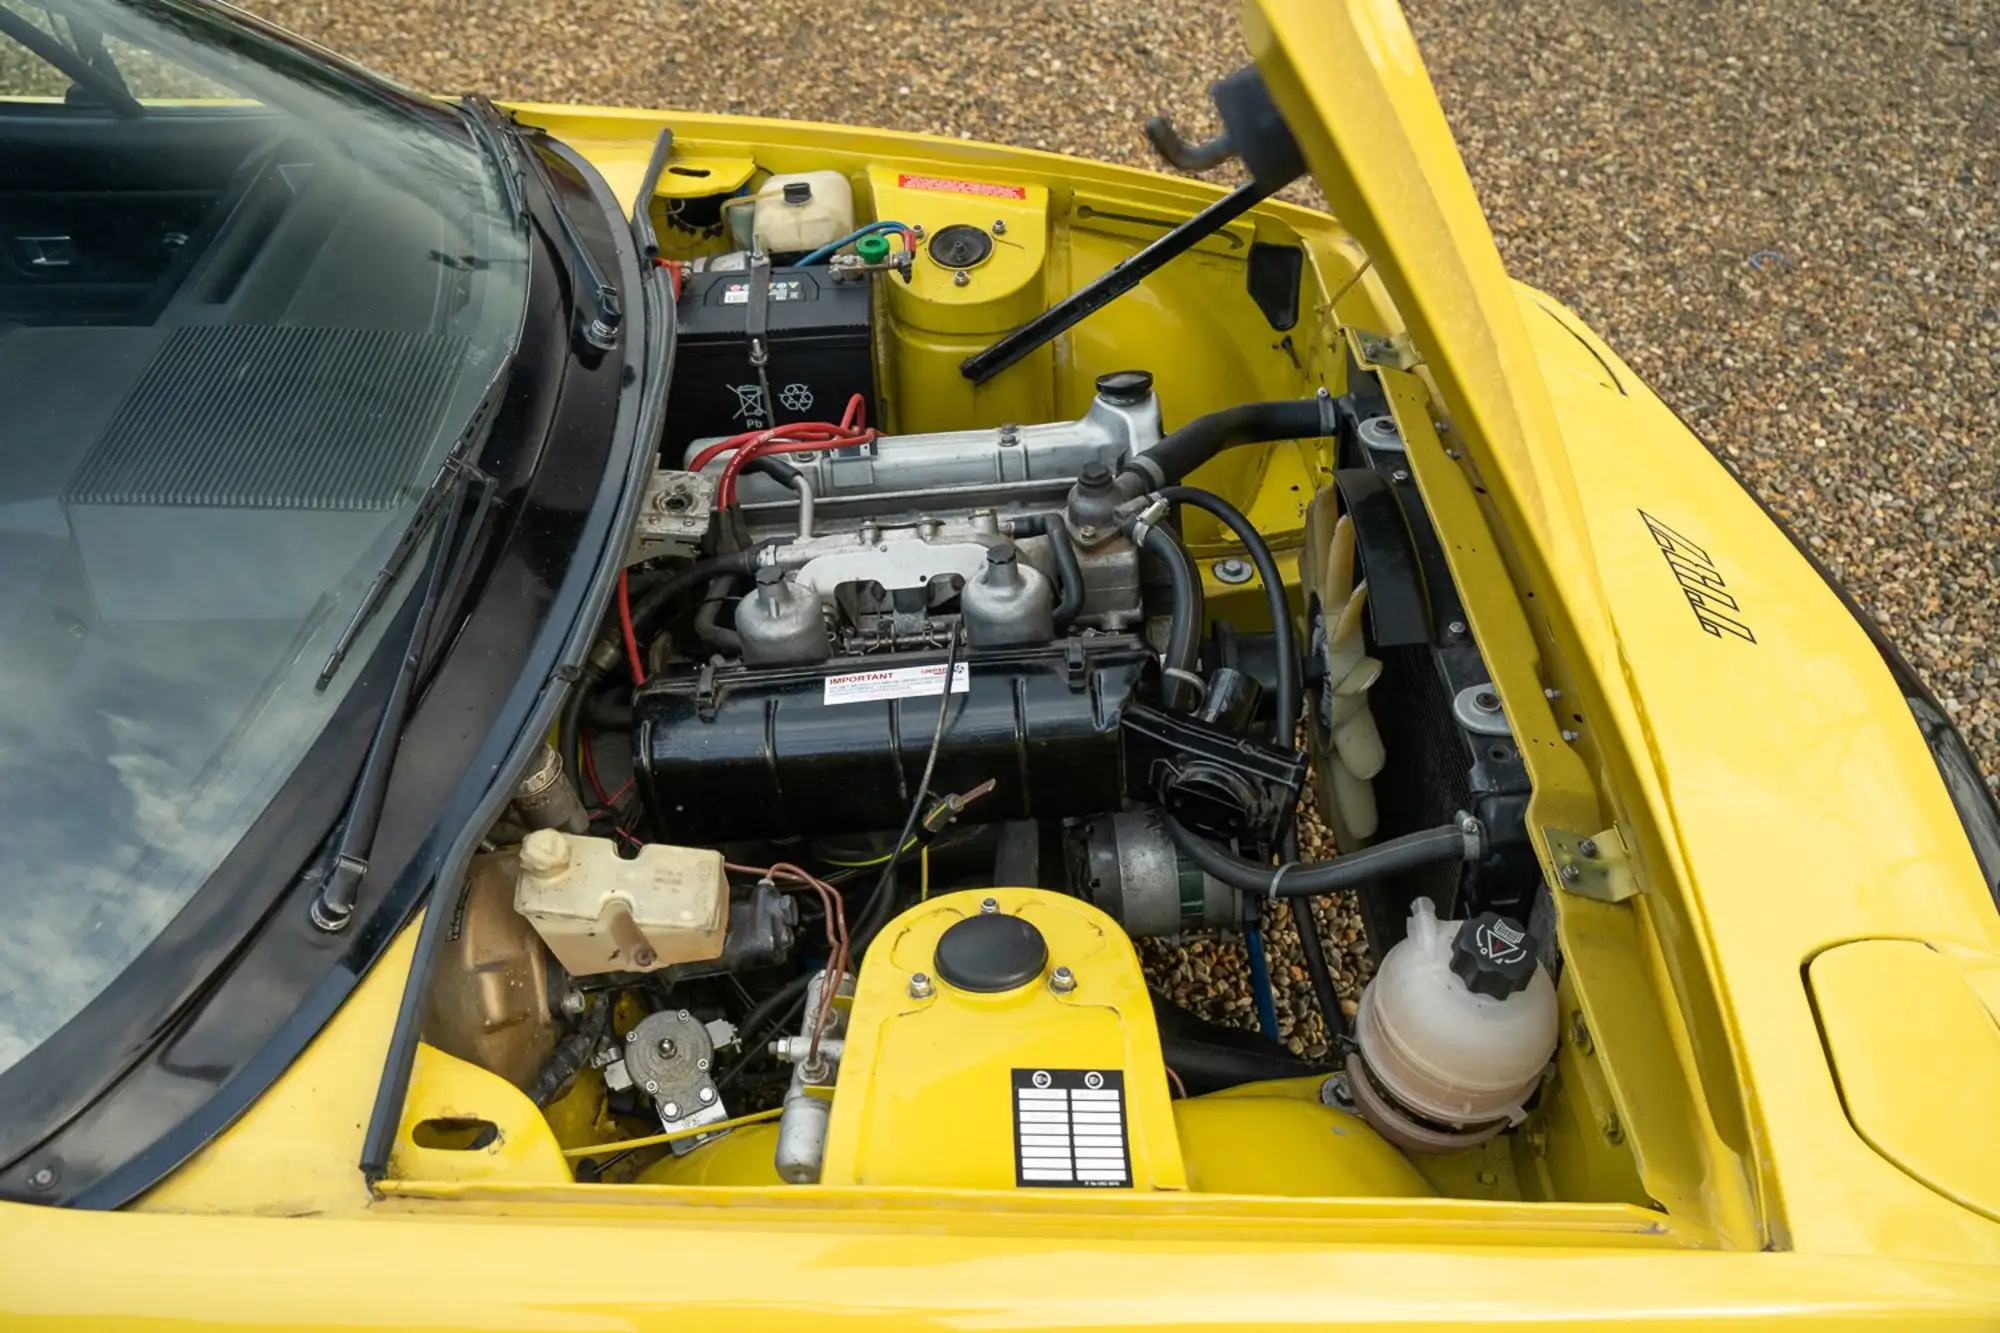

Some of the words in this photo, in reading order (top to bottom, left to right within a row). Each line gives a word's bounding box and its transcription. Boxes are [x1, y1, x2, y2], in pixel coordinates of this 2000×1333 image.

[746, 420, 763, 429] Pb
[1637, 508, 1757, 644] TR7
[829, 672, 895, 685] IMPORTANT
